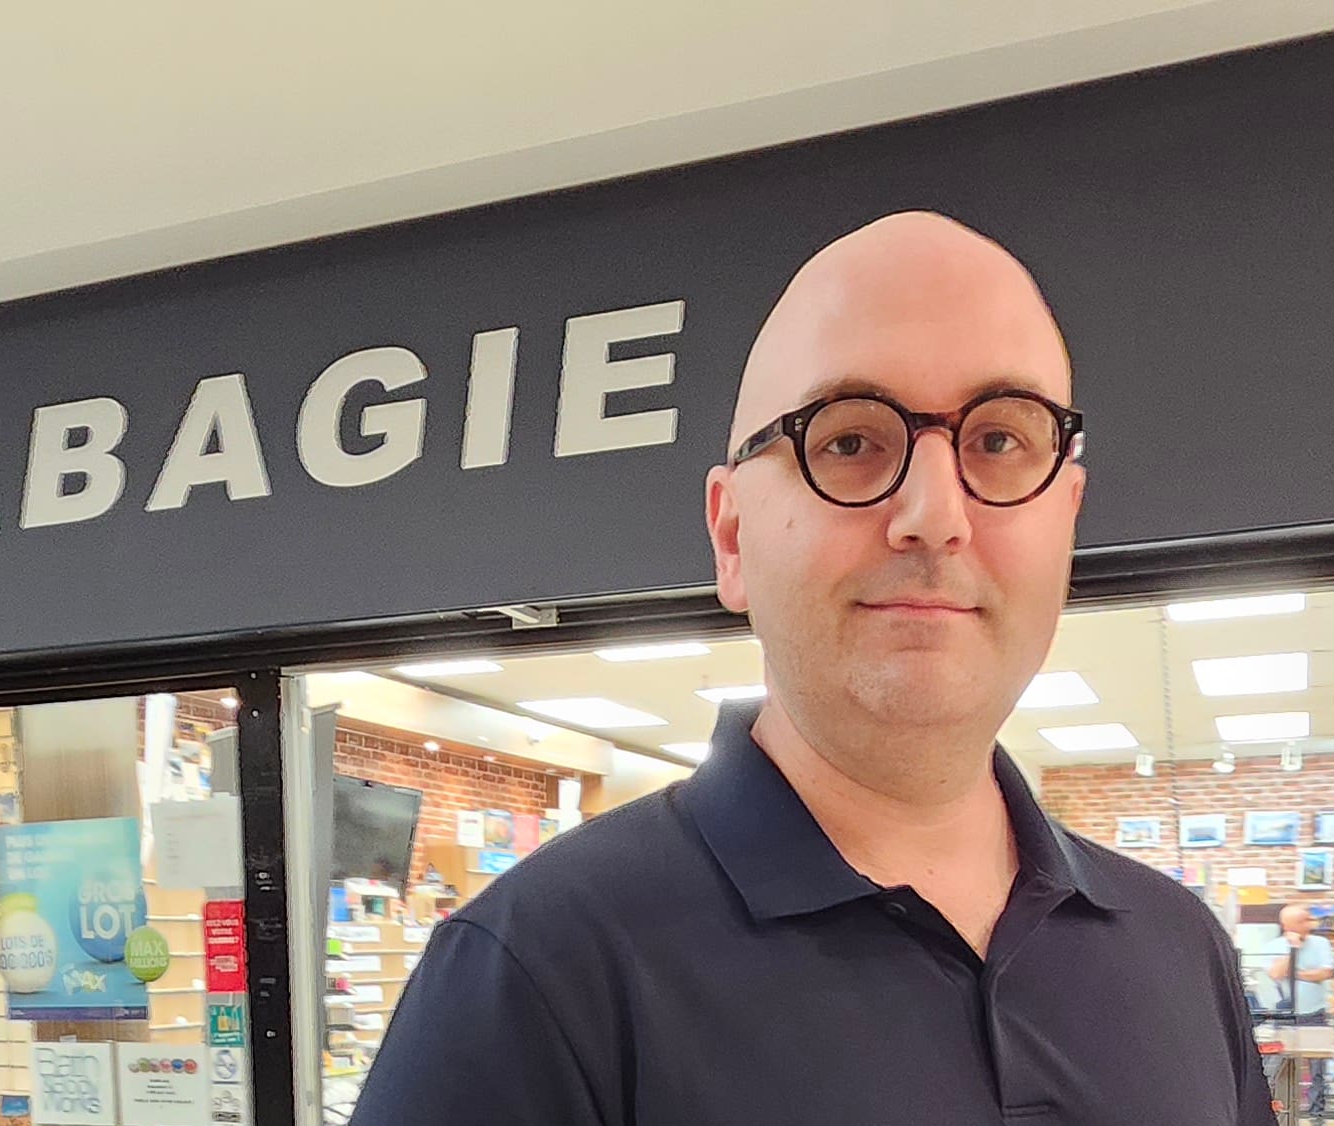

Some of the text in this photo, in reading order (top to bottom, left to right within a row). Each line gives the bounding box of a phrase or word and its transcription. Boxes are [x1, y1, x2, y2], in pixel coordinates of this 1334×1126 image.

[80, 904, 136, 939] LOT
[1, 935, 28, 950] LOTS
[130, 940, 165, 956] MAX
